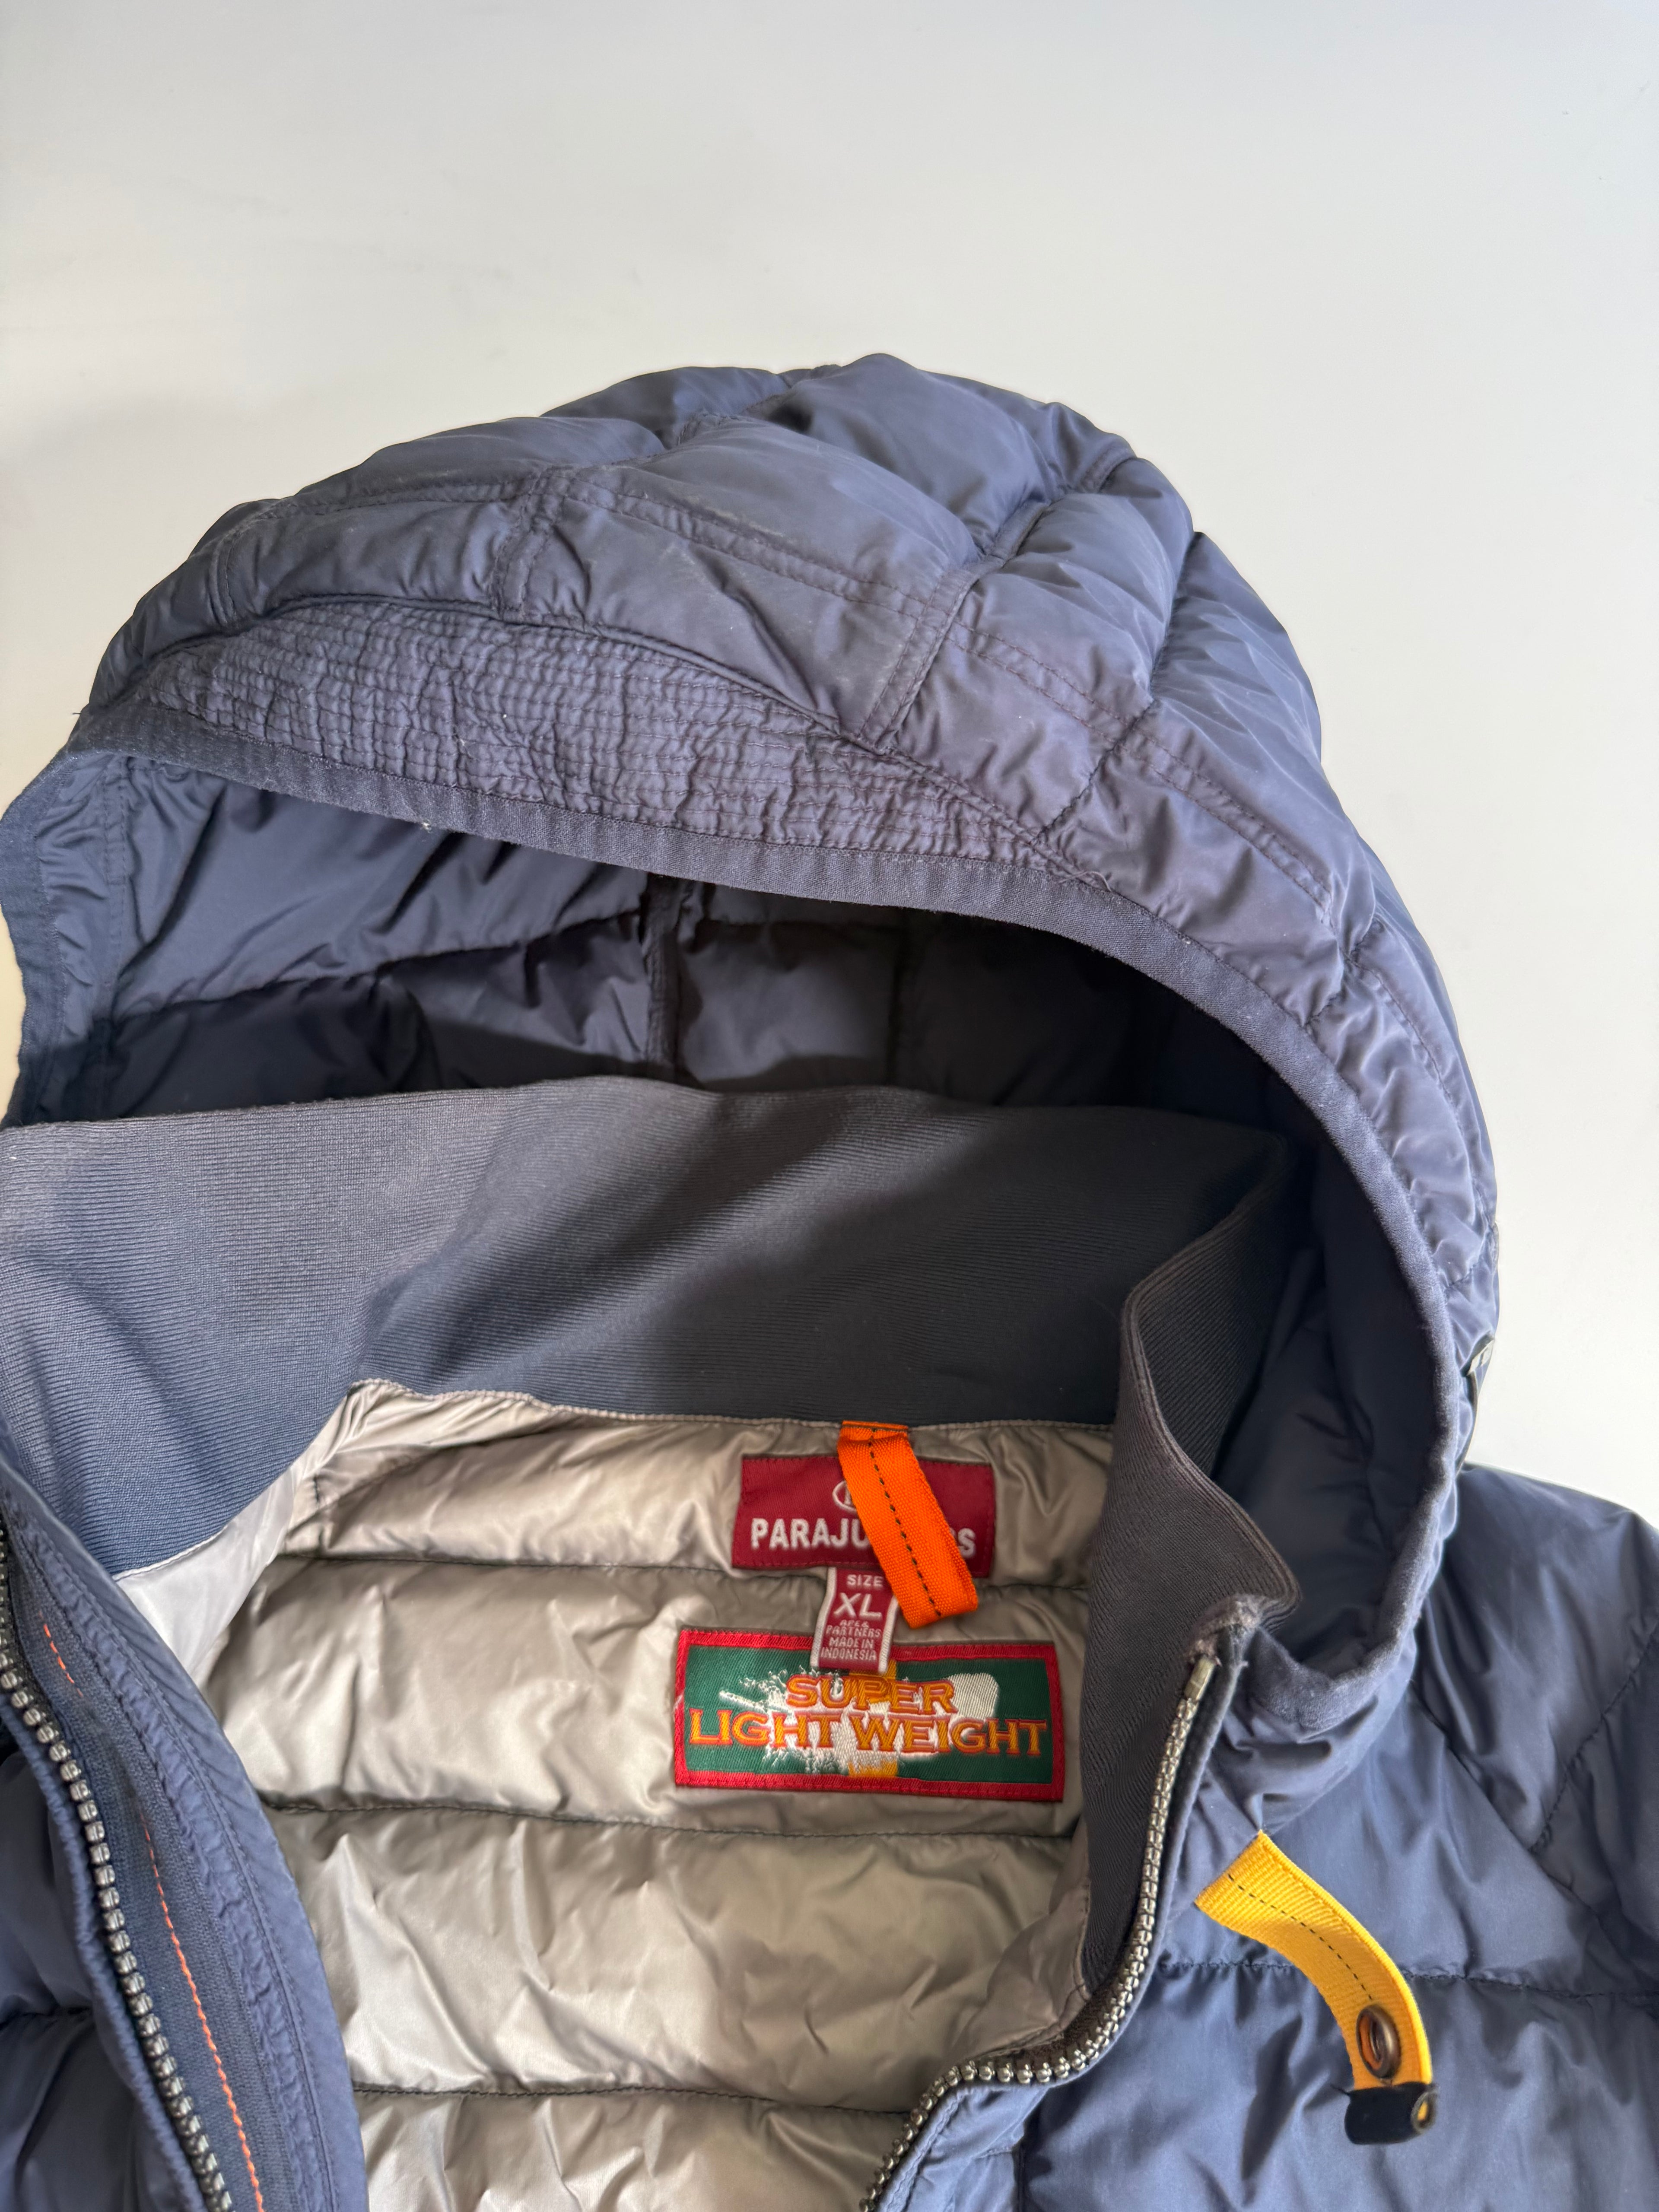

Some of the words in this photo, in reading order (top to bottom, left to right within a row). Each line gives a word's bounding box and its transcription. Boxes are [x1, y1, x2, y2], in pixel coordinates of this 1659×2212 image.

[750, 1518, 977, 1558] PARAJUS
[847, 1574, 884, 1587] SIZE
[833, 1592, 882, 1618] XL
[826, 1625, 882, 1638] PARTNERS
[829, 1637, 859, 1648] MADE
[861, 1639, 874, 1649] IN
[821, 1647, 877, 1661] INDONESIA
[786, 1674, 957, 1714] SUPER
